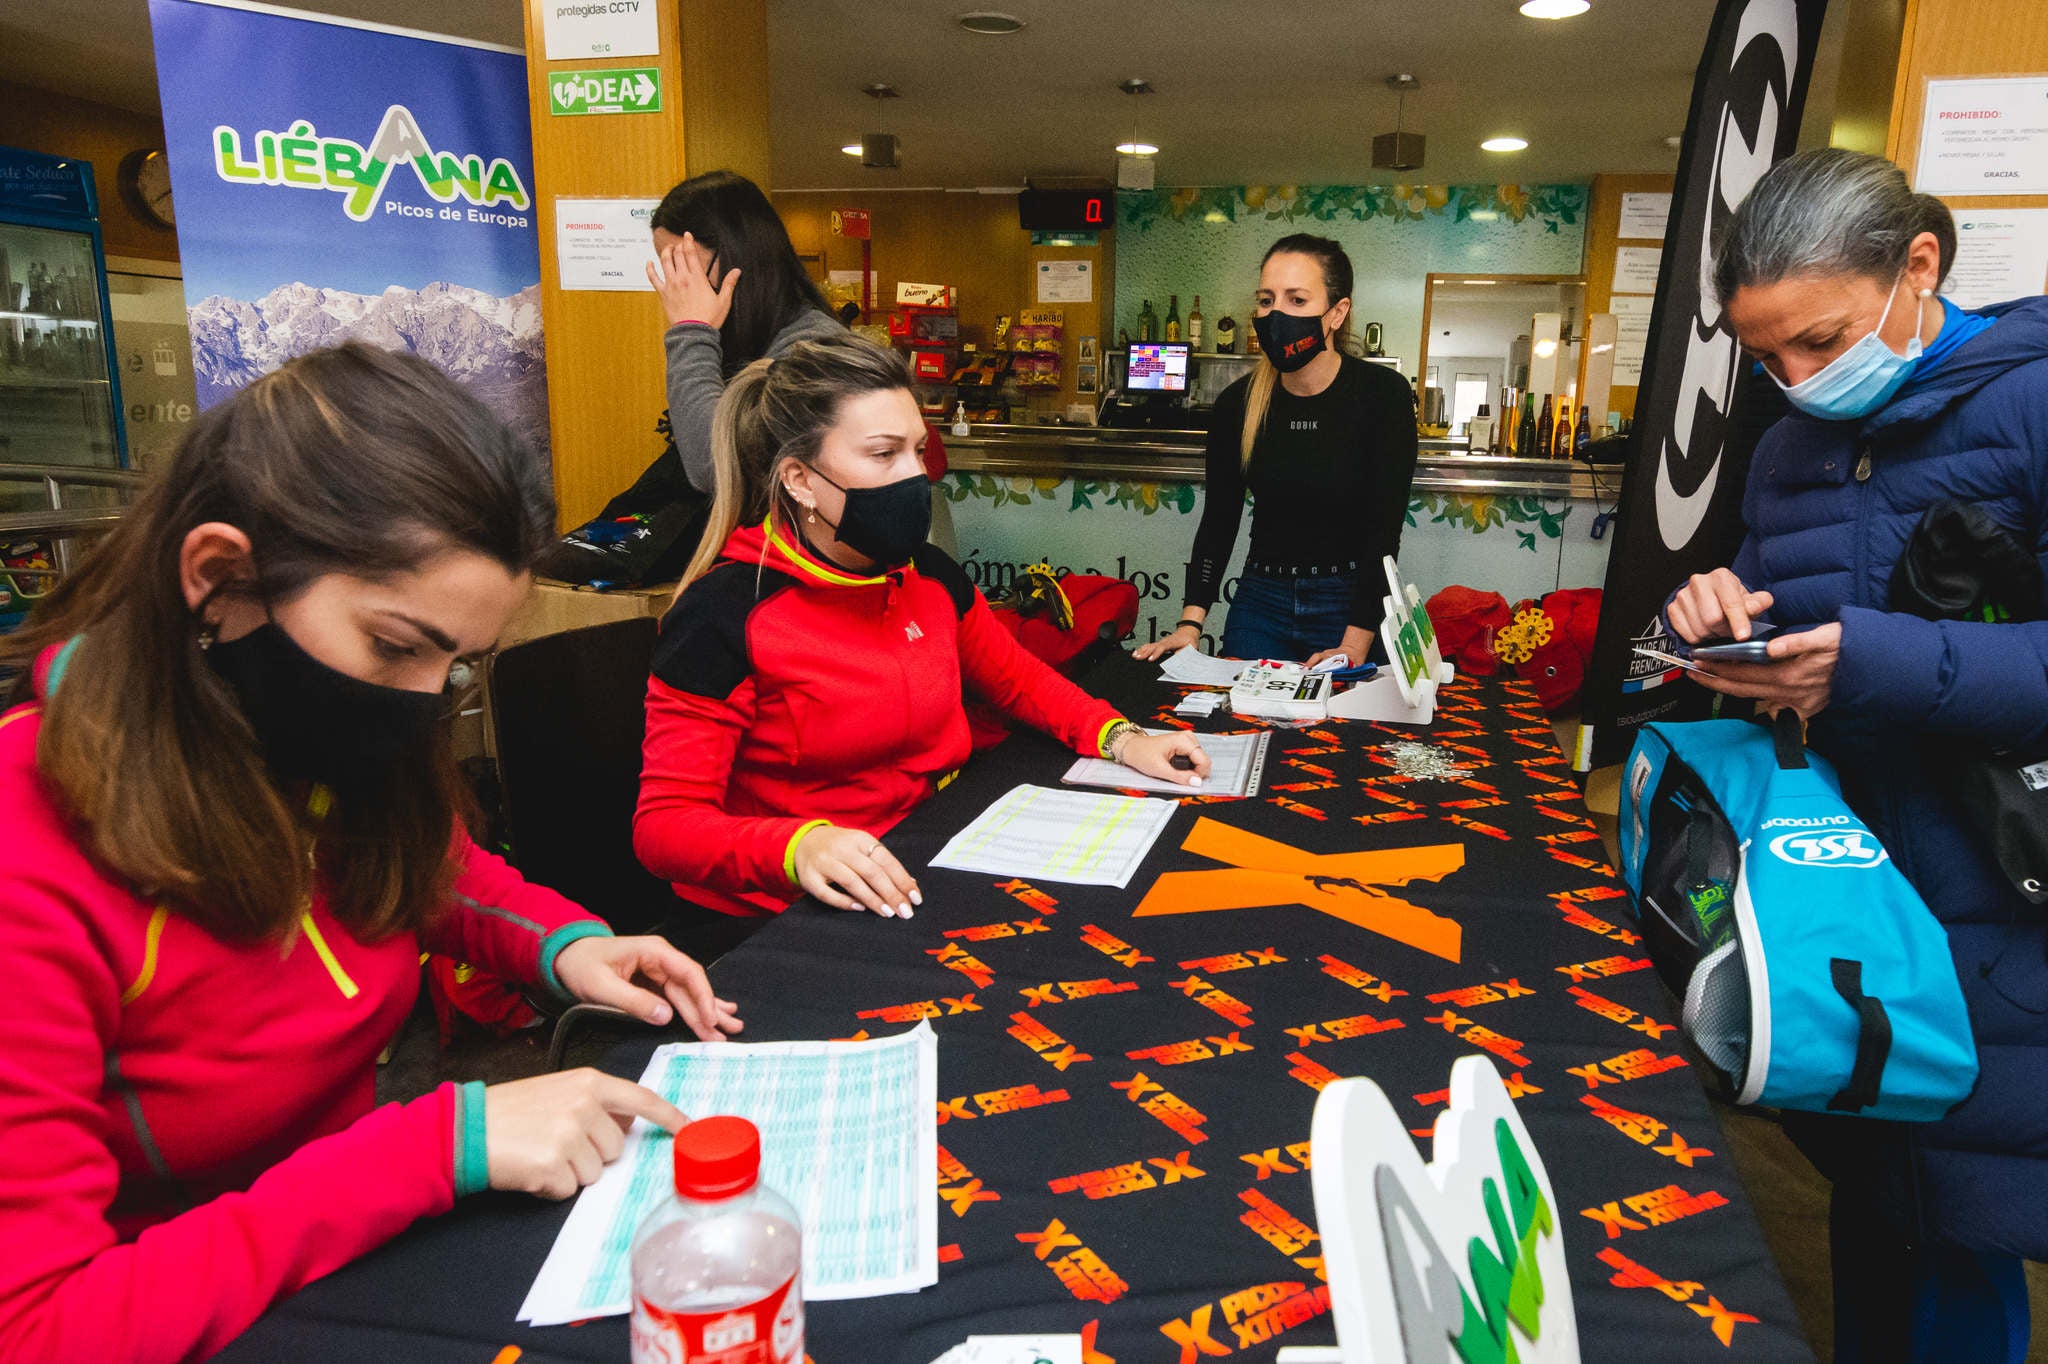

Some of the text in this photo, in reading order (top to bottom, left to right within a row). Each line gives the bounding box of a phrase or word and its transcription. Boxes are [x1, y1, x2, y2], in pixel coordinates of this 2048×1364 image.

[556, 1, 639, 19] protegidas CCTV
[584, 78, 636, 103] DEA
[1938, 110, 2002, 120] PROHIBIDO:
[213, 105, 530, 222] LIÉBANA
[385, 201, 528, 228] Picos de Europa
[1032, 313, 1062, 322] HARIBO
[130, 400, 192, 422] ente
[1290, 420, 1318, 430] GOBIK
[1629, 658, 1661, 676] FRENCH
